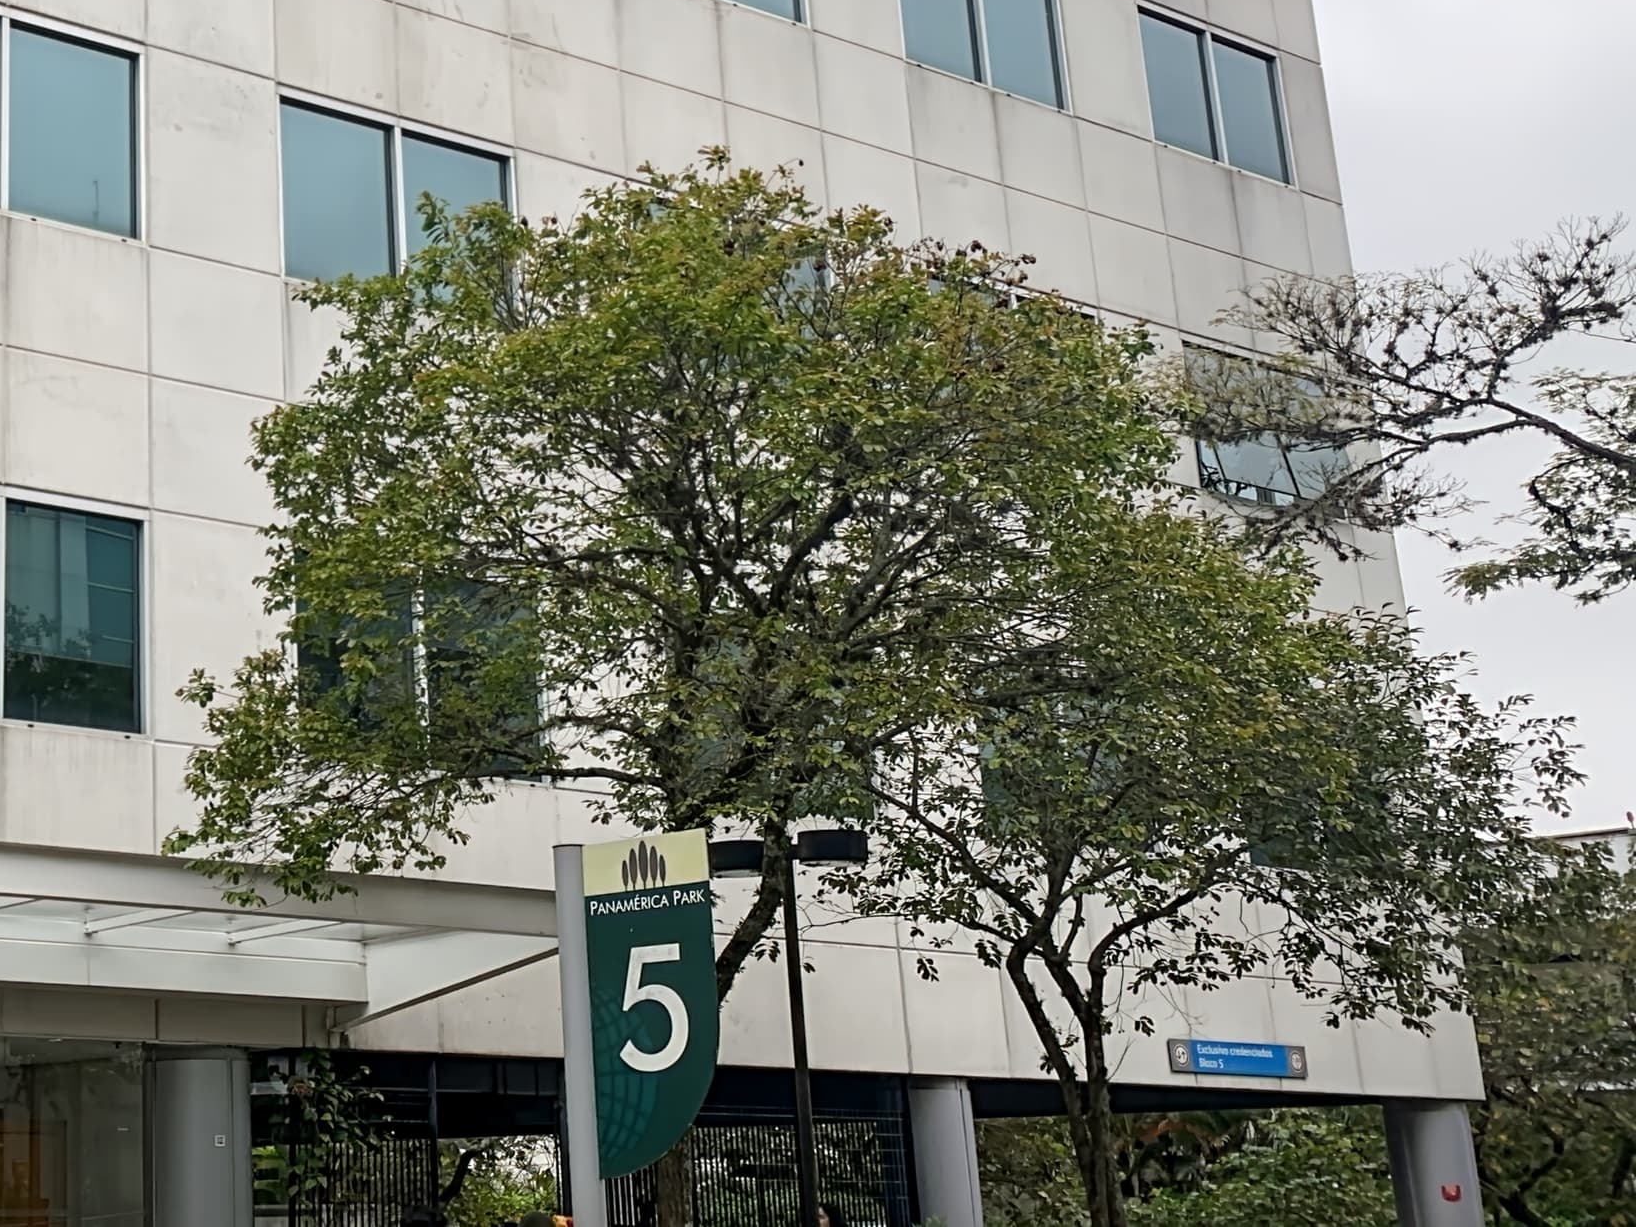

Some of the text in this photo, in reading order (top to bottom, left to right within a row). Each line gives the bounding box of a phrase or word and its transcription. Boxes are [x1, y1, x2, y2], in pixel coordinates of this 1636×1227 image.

[590, 889, 705, 916] PANAMÉRICA PARK
[619, 942, 689, 1072] 5
[1196, 1044, 1273, 1058] Exclusivo credenciados
[1198, 1057, 1224, 1069] Bloco 5
